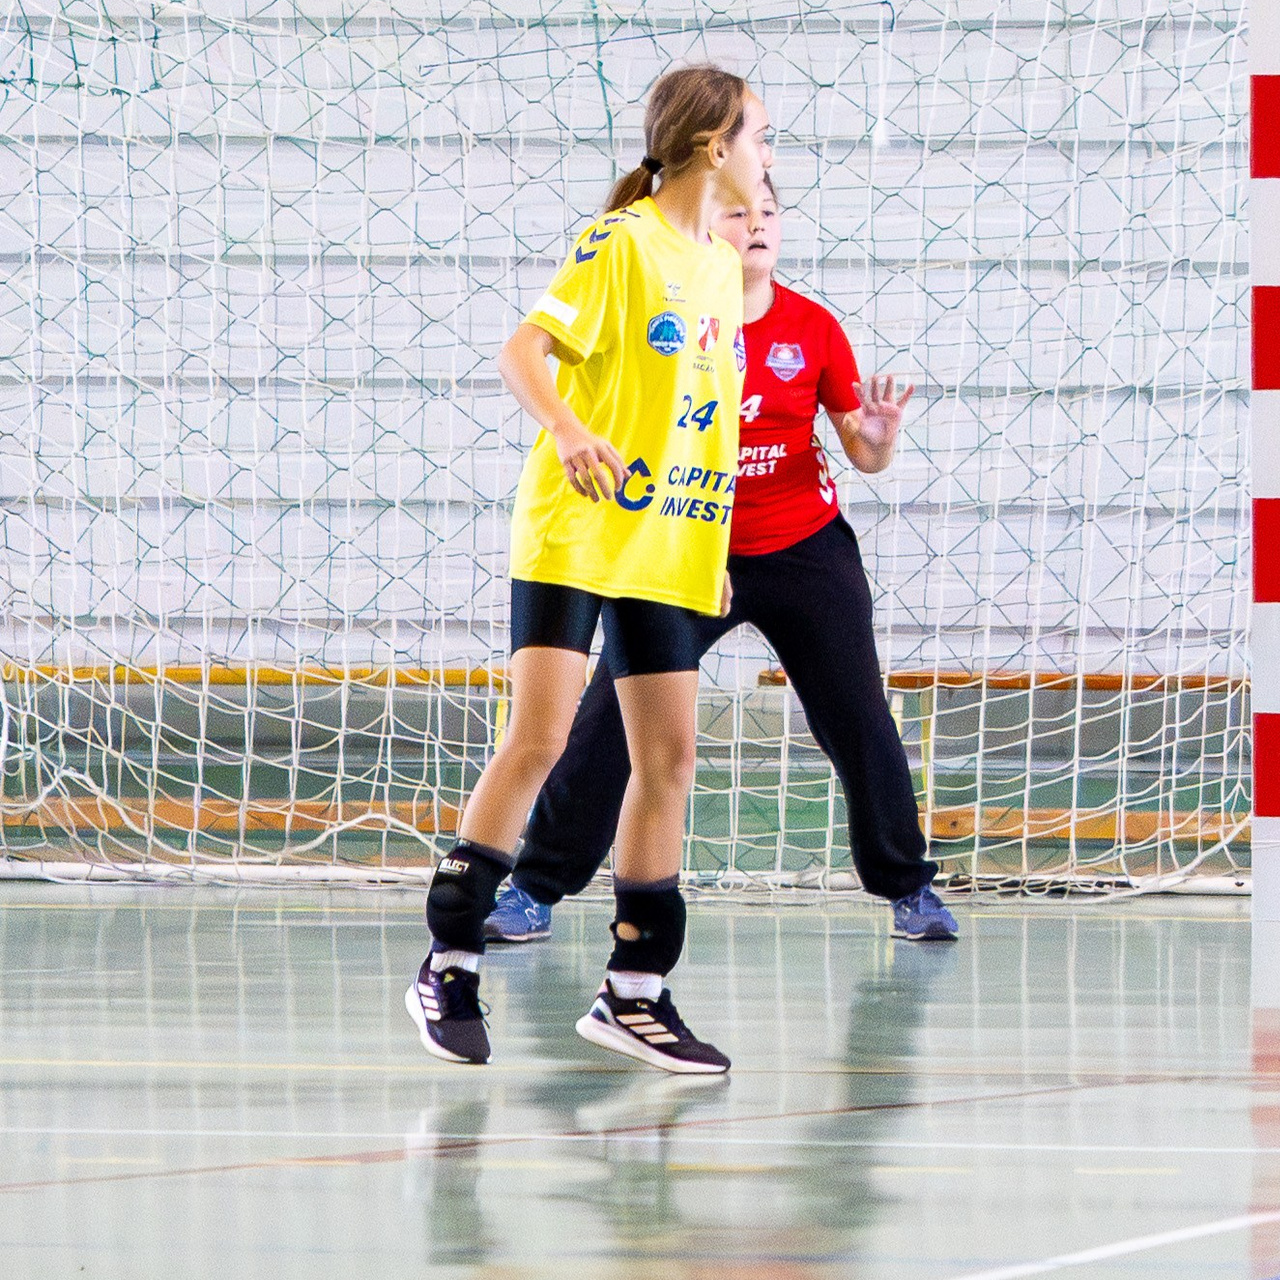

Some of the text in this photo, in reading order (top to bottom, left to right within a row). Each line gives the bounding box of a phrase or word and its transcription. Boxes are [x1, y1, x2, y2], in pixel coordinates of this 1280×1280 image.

[677, 394, 718, 432] 24
[738, 444, 787, 461] PITAL
[668, 465, 736, 495] CAPITA
[736, 460, 777, 477] VEST
[660, 496, 732, 525] INVEST
